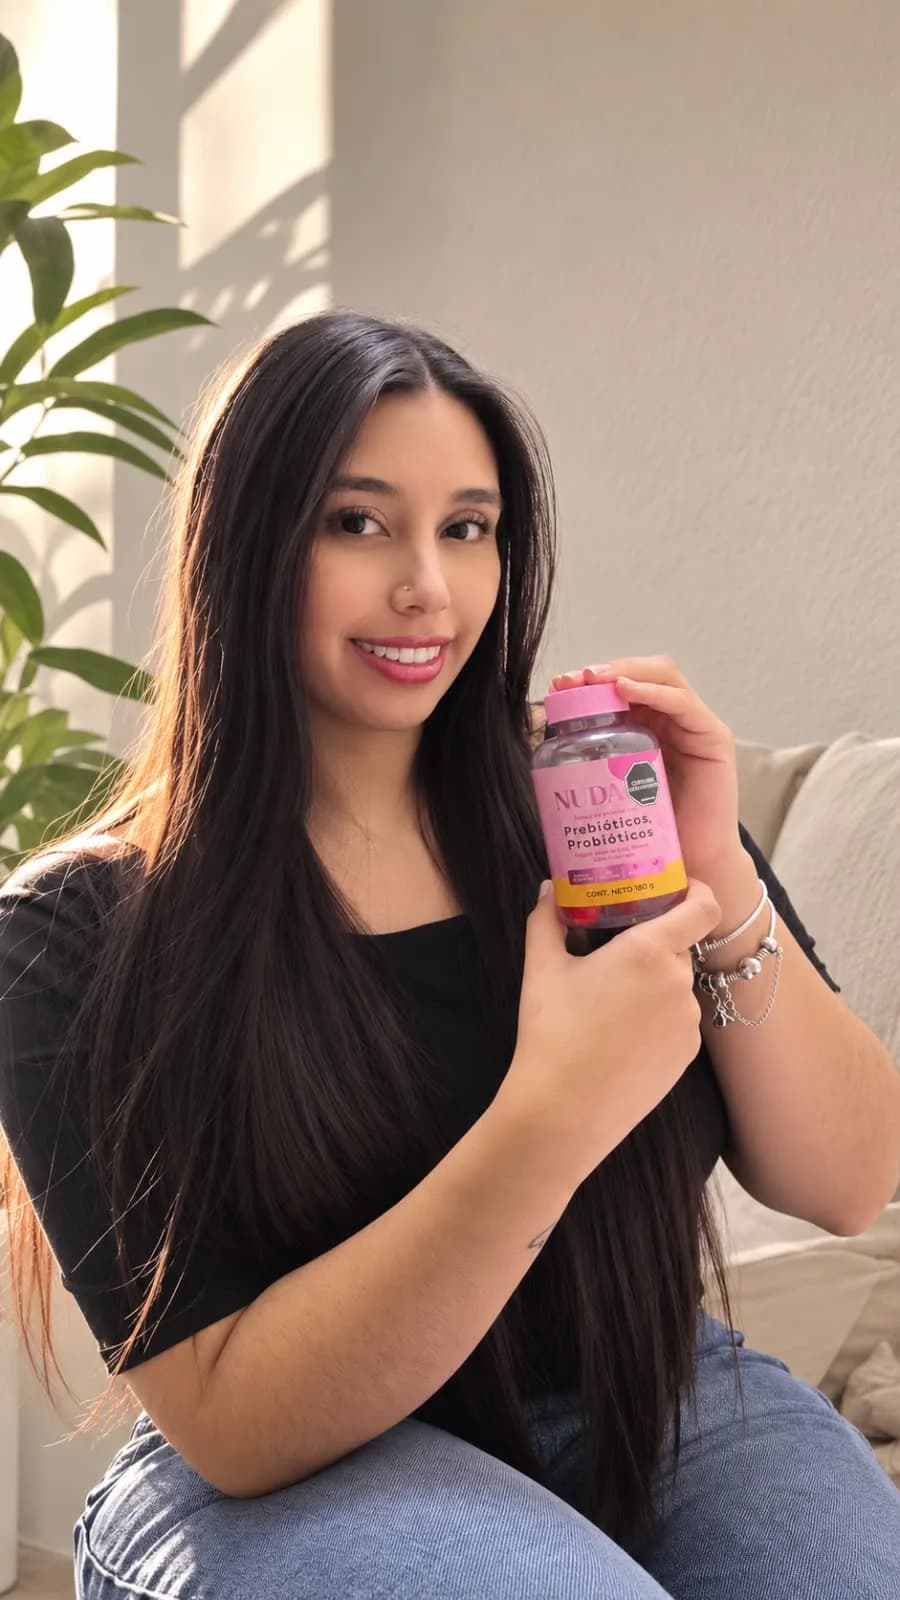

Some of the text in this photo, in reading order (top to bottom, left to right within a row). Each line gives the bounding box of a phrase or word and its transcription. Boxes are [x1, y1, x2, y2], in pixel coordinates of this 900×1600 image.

[564, 816, 652, 836] Prebióticos,
[568, 829, 653, 850] Probióticos
[586, 889, 610, 898] CONT.
[611, 886, 633, 896] NETO
